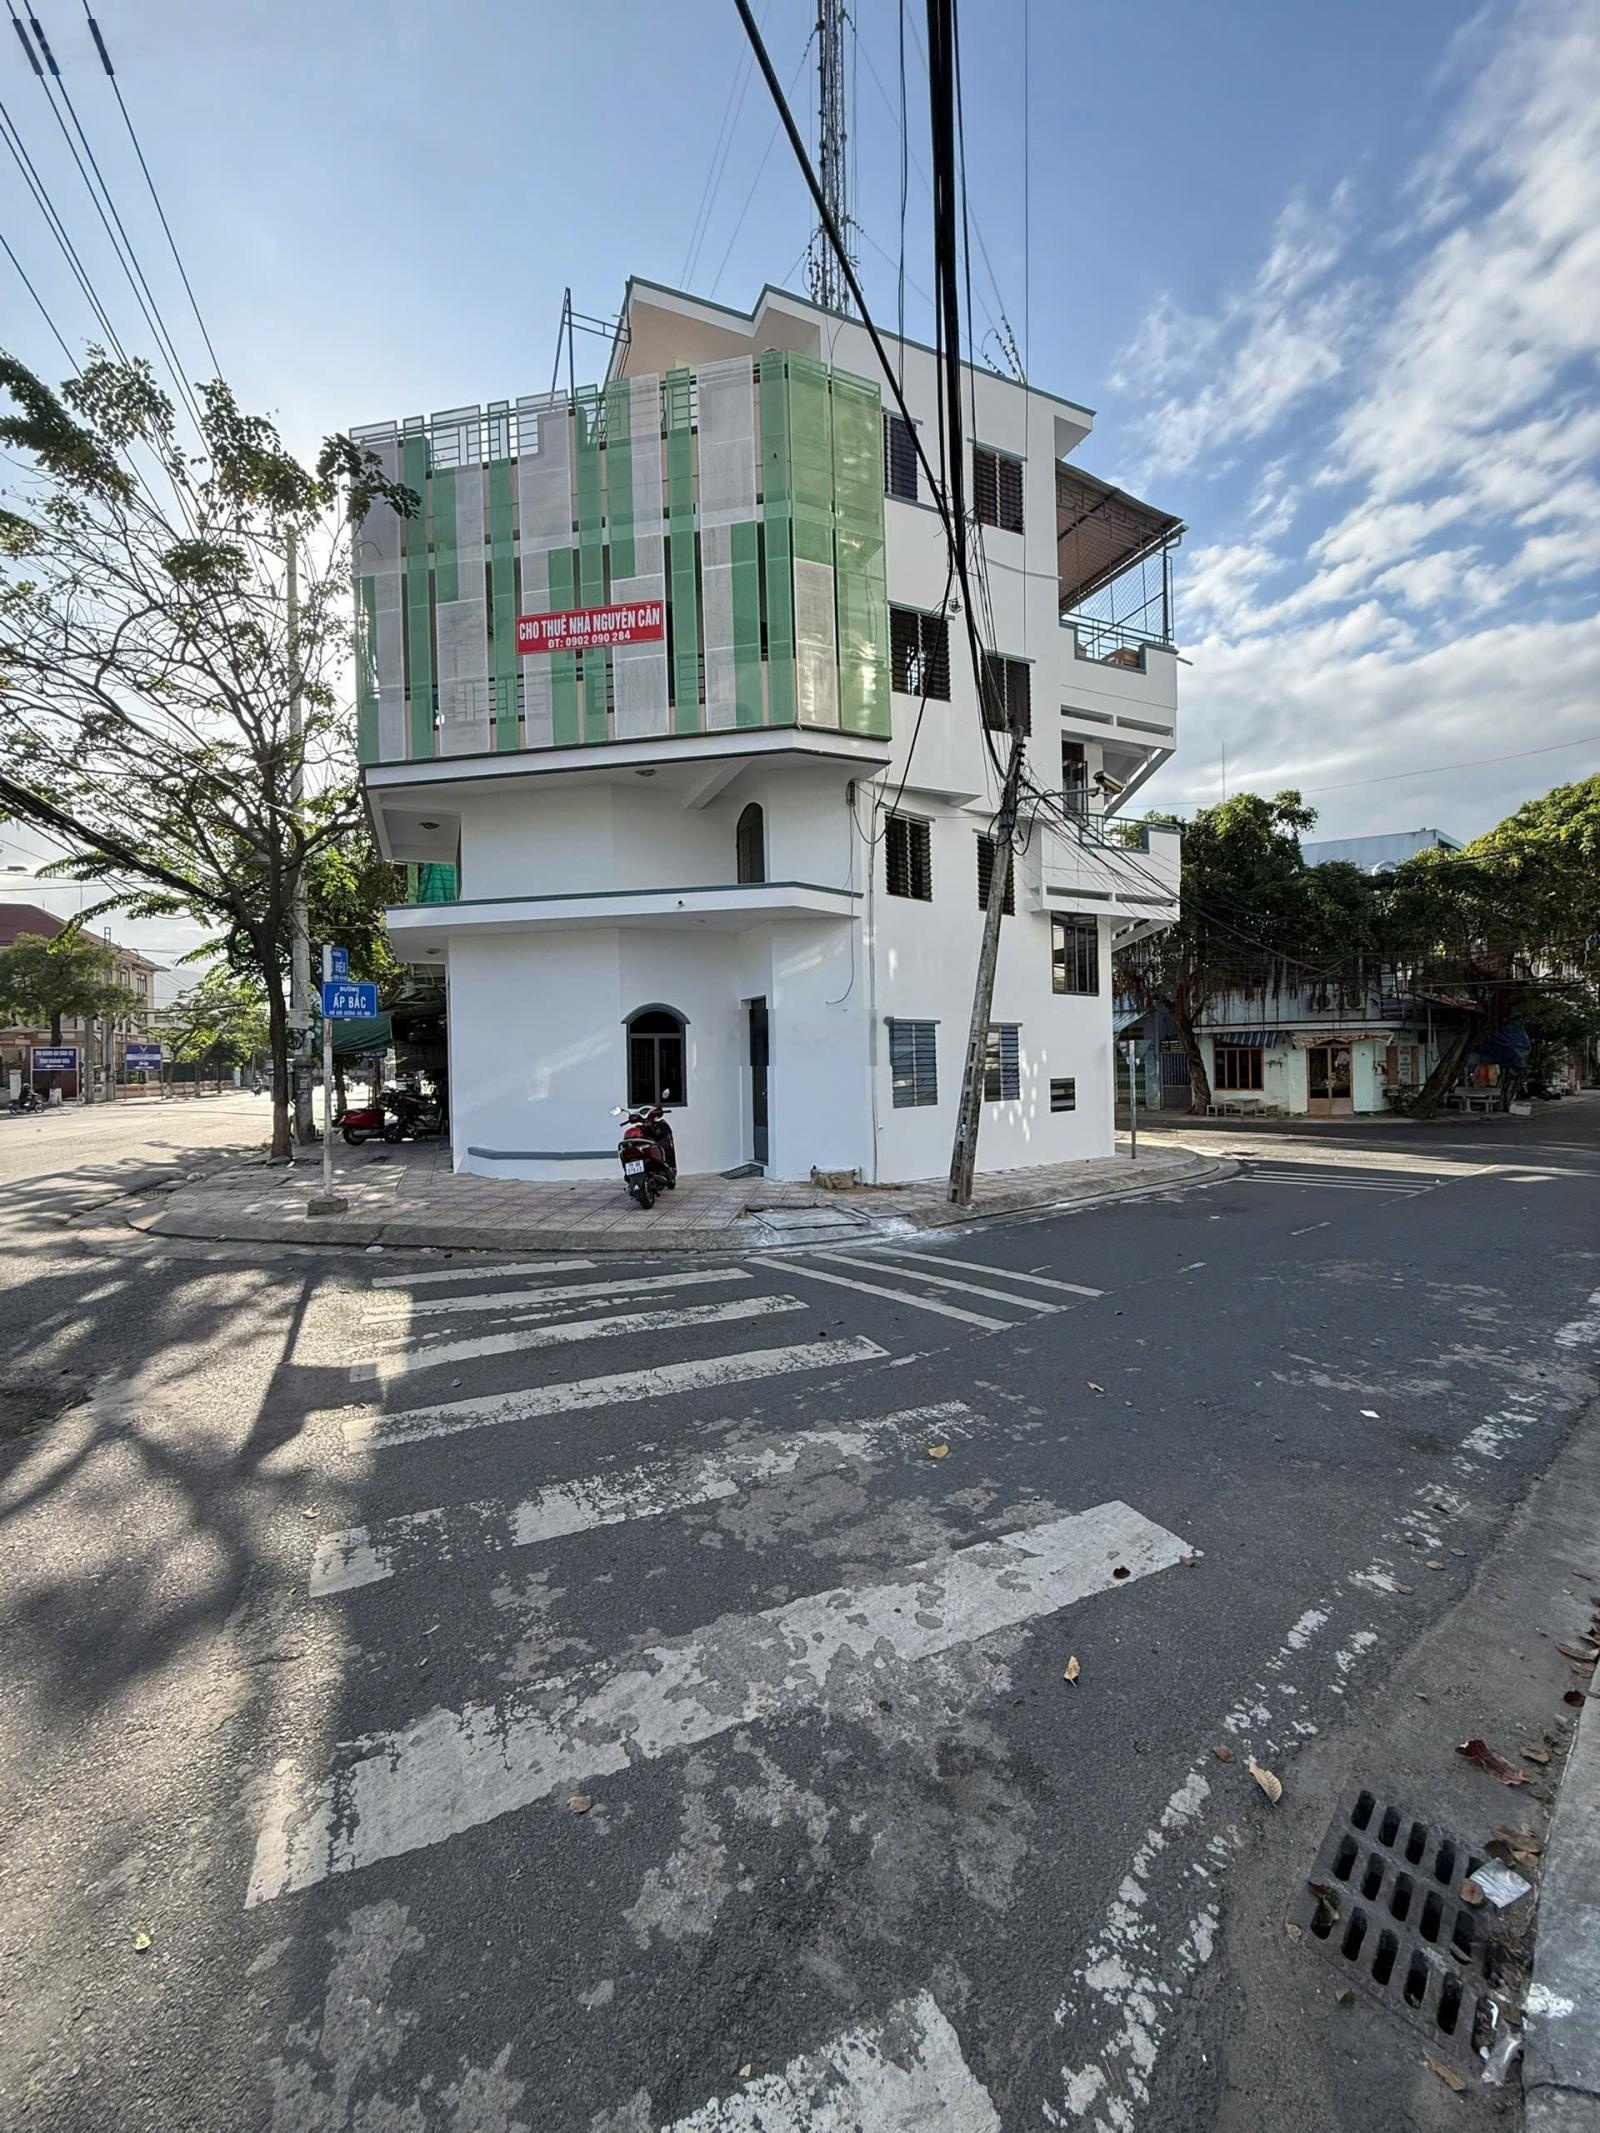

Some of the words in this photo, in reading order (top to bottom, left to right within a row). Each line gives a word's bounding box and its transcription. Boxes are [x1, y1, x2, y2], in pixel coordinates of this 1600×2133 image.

[519, 621, 539, 640] CHO
[541, 614, 567, 638] THUÊ
[569, 612, 590, 634] NHÀ
[593, 607, 636, 630] NGUYÊN
[638, 604, 660, 627] CĂN
[548, 638, 563, 648] ĐT:
[565, 636, 589, 647] 0902
[591, 633, 610, 643] 090
[612, 630, 630, 641] 284
[333, 992, 346, 1009] ẤP
[348, 993, 367, 1009] BẮC
